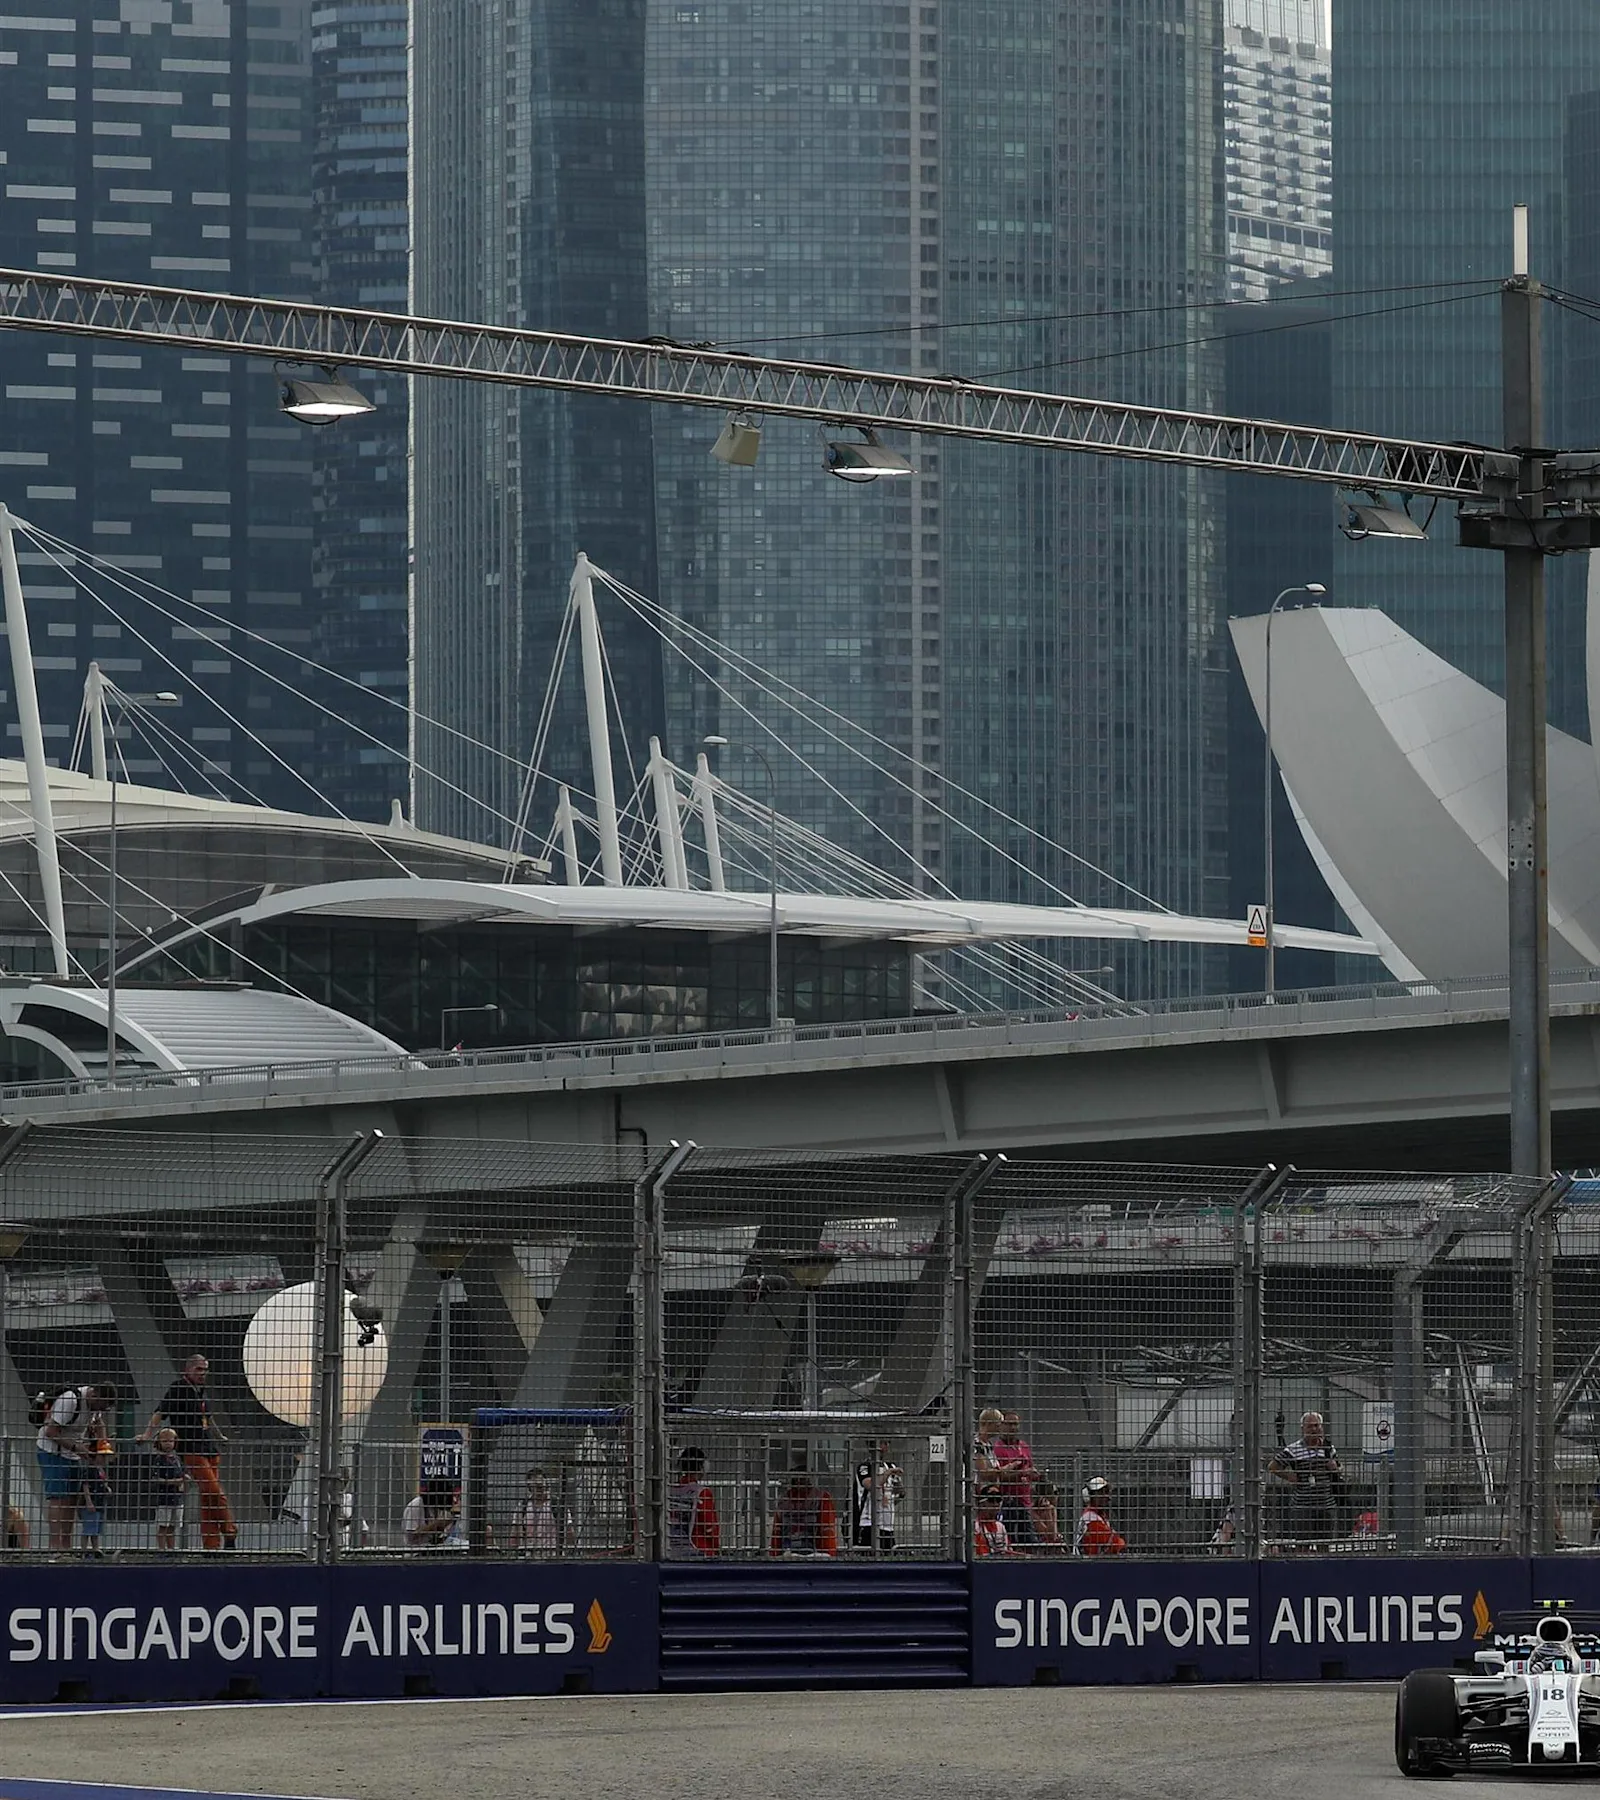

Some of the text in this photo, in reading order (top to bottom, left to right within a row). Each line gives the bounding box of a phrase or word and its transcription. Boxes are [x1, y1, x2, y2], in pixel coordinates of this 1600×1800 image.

[9, 1603, 575, 1662] SINGAPORE AIRLINES
[995, 1594, 1463, 1648] SINGAPORE AIRLINES
[1542, 1688, 1565, 1701] 18
